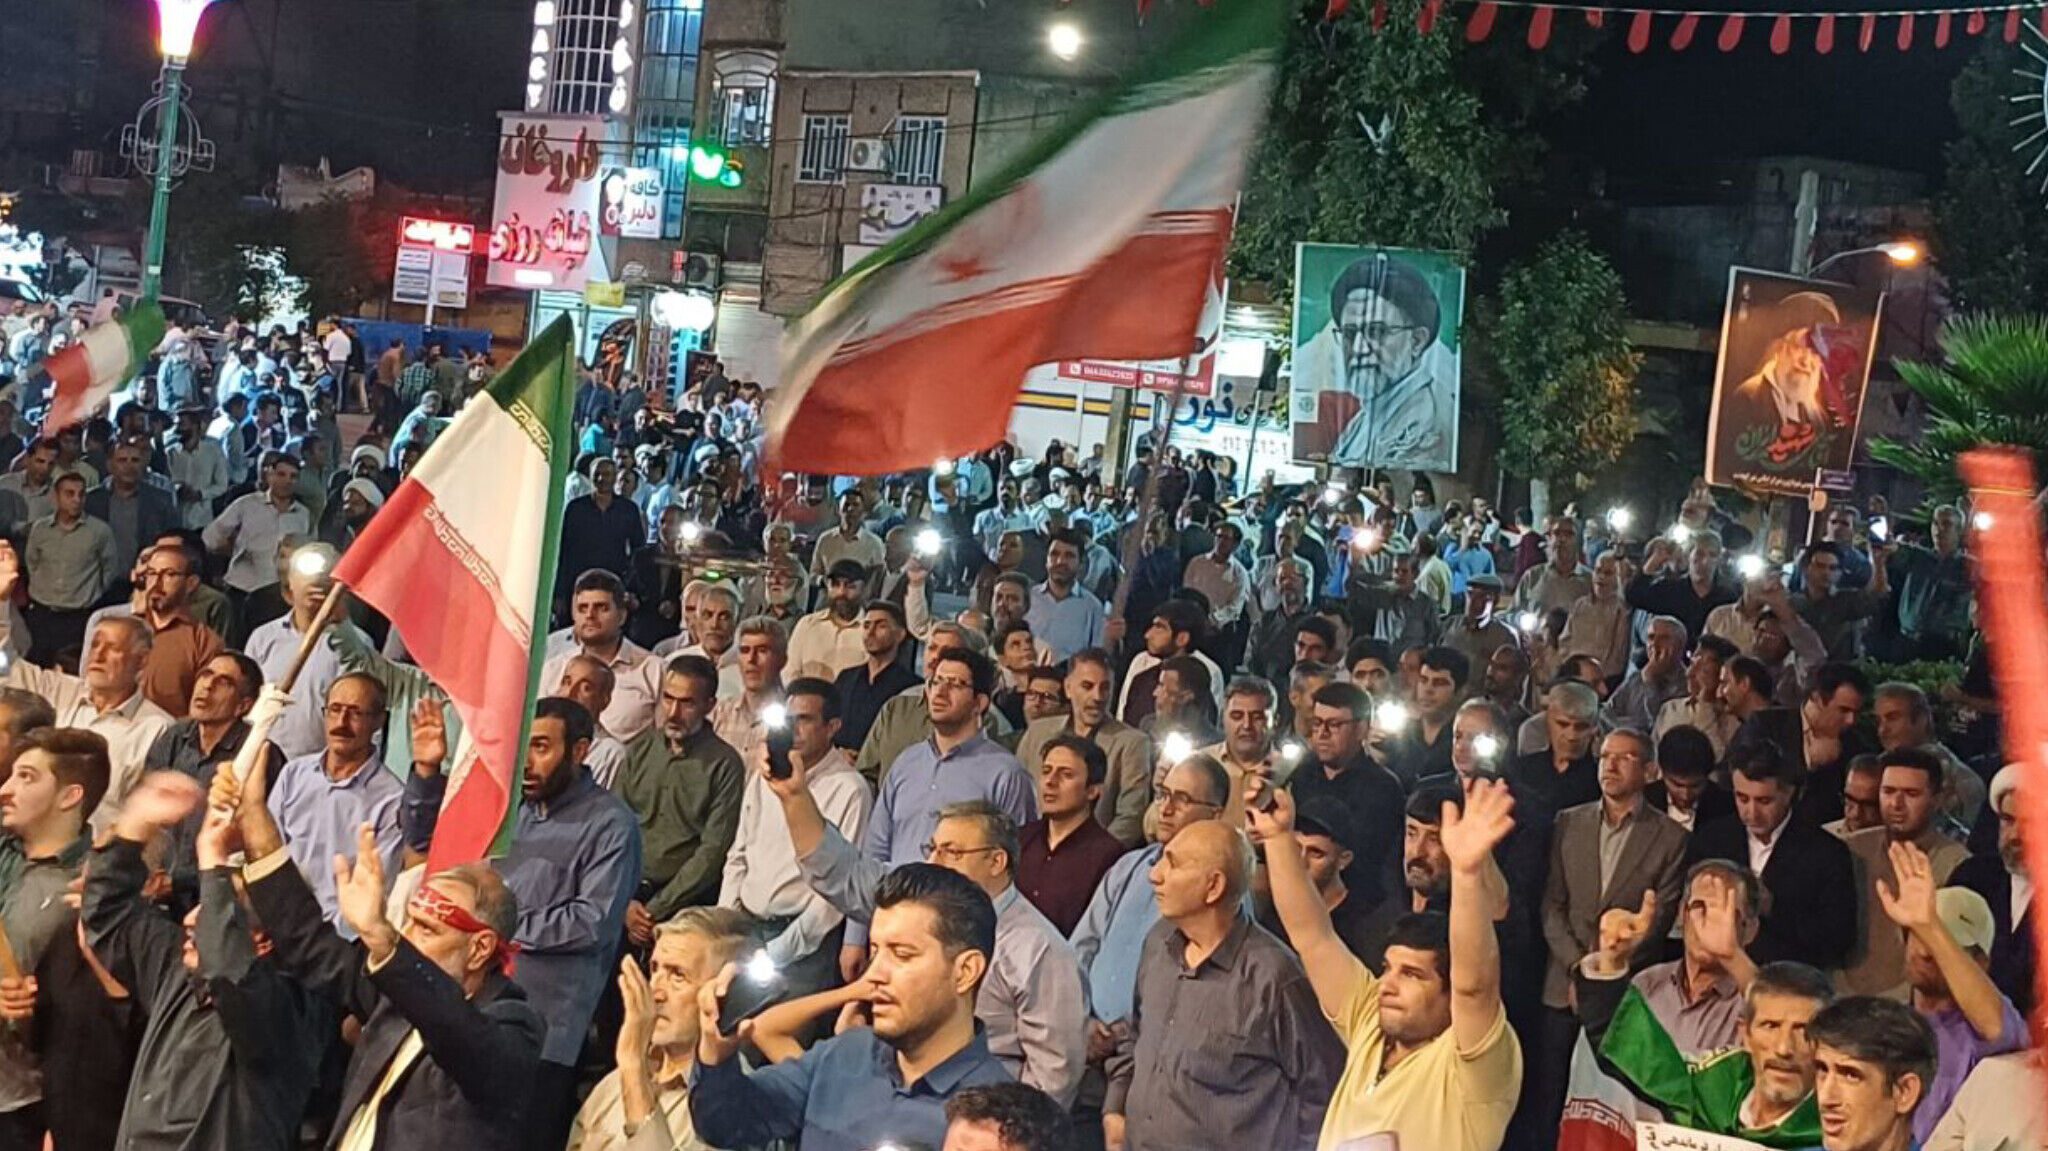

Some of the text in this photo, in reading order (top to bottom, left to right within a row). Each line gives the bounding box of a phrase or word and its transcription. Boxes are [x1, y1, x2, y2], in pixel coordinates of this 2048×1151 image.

[500, 121, 599, 194] داروخانه
[631, 179, 660, 197] کافه
[629, 202, 656, 226] دلبر
